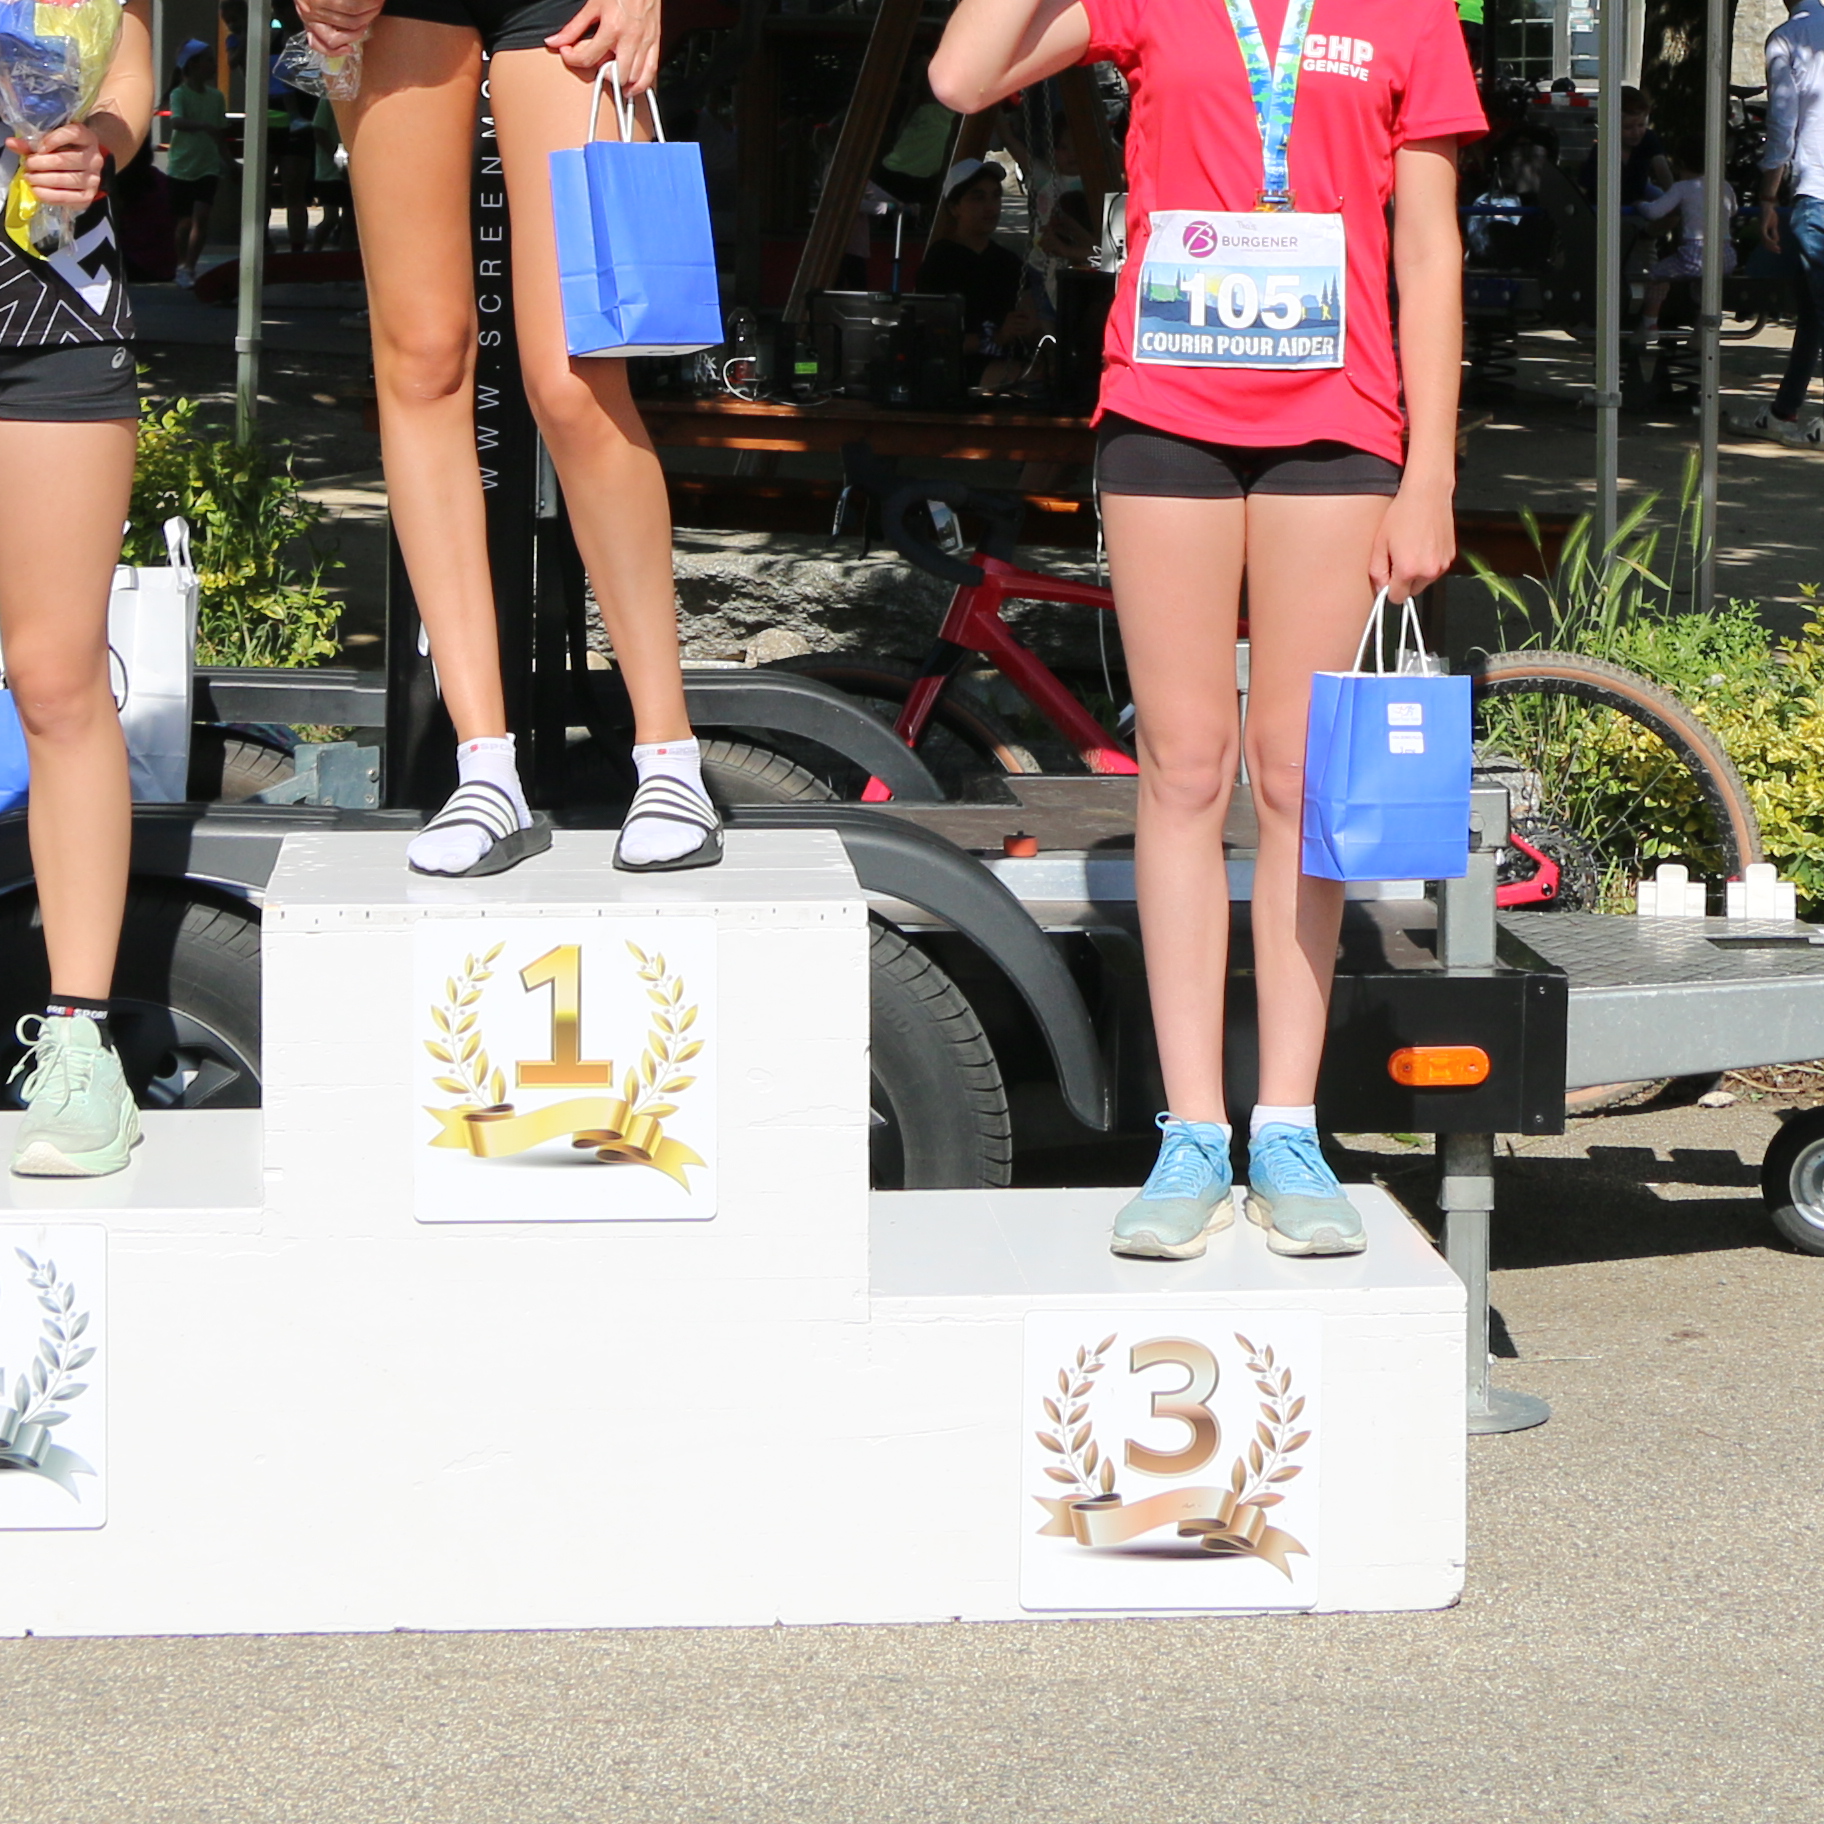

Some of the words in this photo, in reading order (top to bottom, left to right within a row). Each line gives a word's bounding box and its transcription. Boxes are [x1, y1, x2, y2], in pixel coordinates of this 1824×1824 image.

[1302, 32, 1374, 66] CHP
[1302, 58, 1370, 82] GENEVE
[1221, 235, 1299, 248] BURGENER
[1180, 272, 1302, 331] 105
[1141, 332, 1213, 354] COURIR
[1217, 335, 1273, 356] POUR
[1276, 336, 1334, 357] AIDER
[514, 941, 615, 1091] 1
[1123, 1335, 1222, 1478] 3
